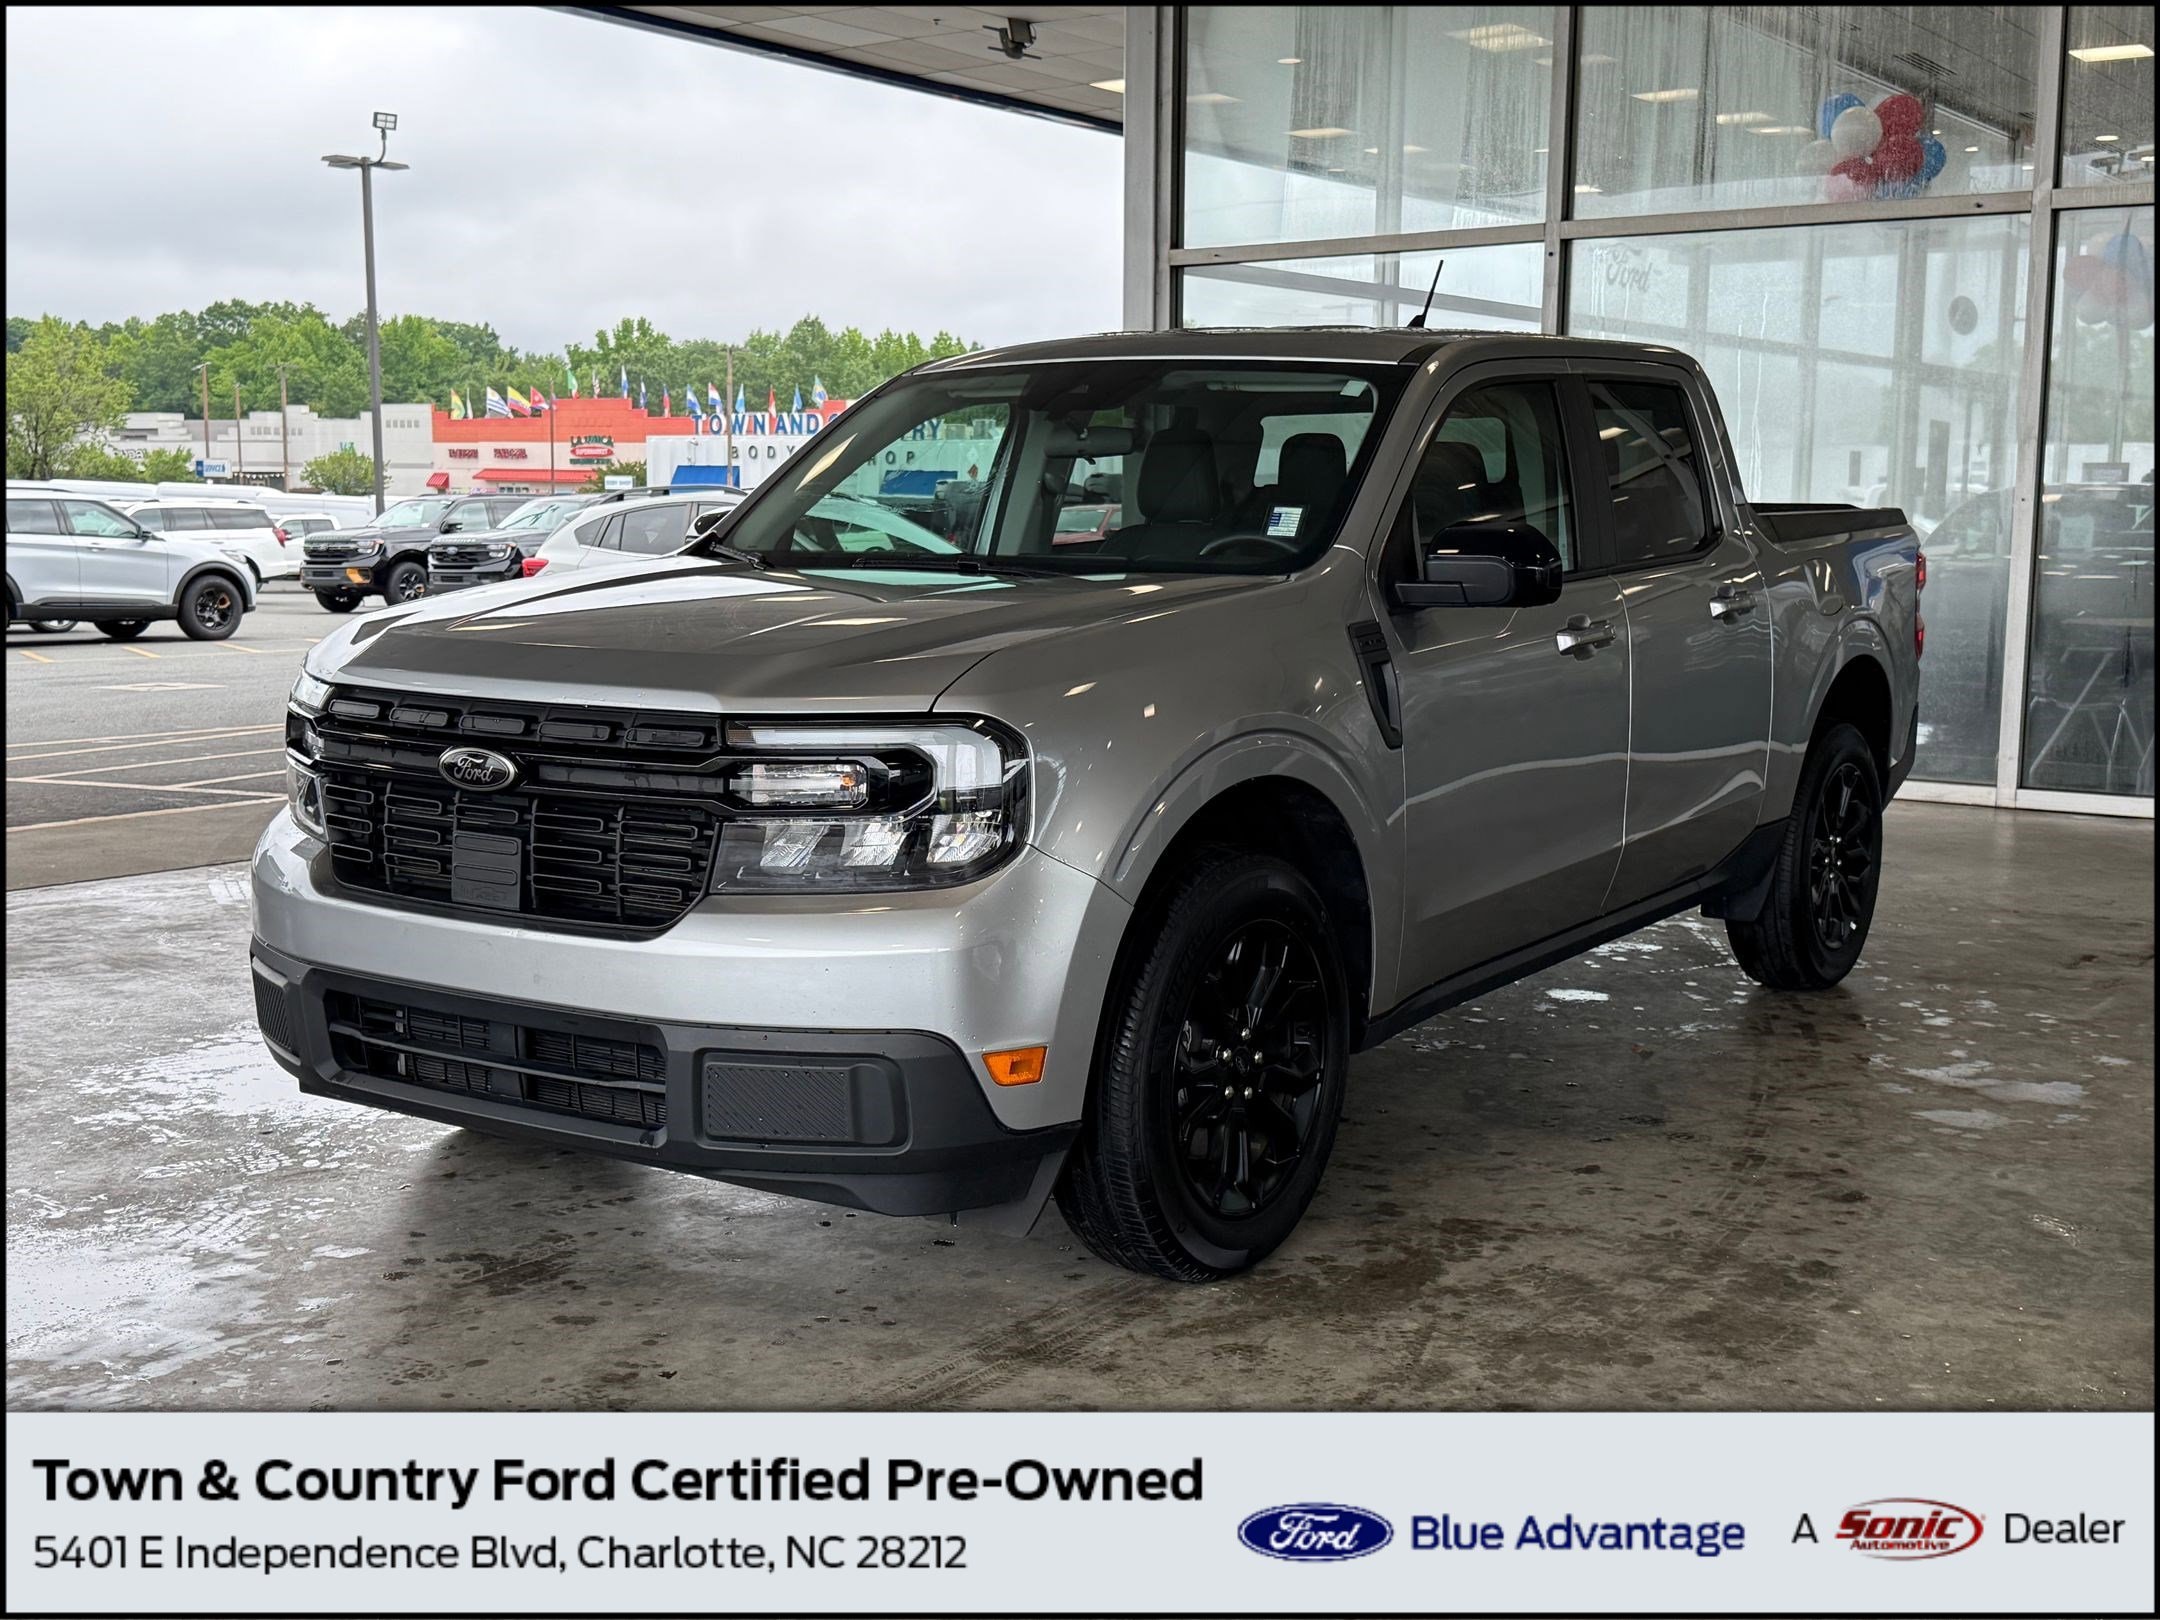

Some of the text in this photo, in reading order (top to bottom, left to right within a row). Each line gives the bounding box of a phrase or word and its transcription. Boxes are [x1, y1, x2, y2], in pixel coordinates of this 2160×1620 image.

[691, 413, 766, 435] TOWN
[775, 413, 819, 435] AND
[731, 445, 796, 459] BODY
[453, 756, 495, 783] Ford
